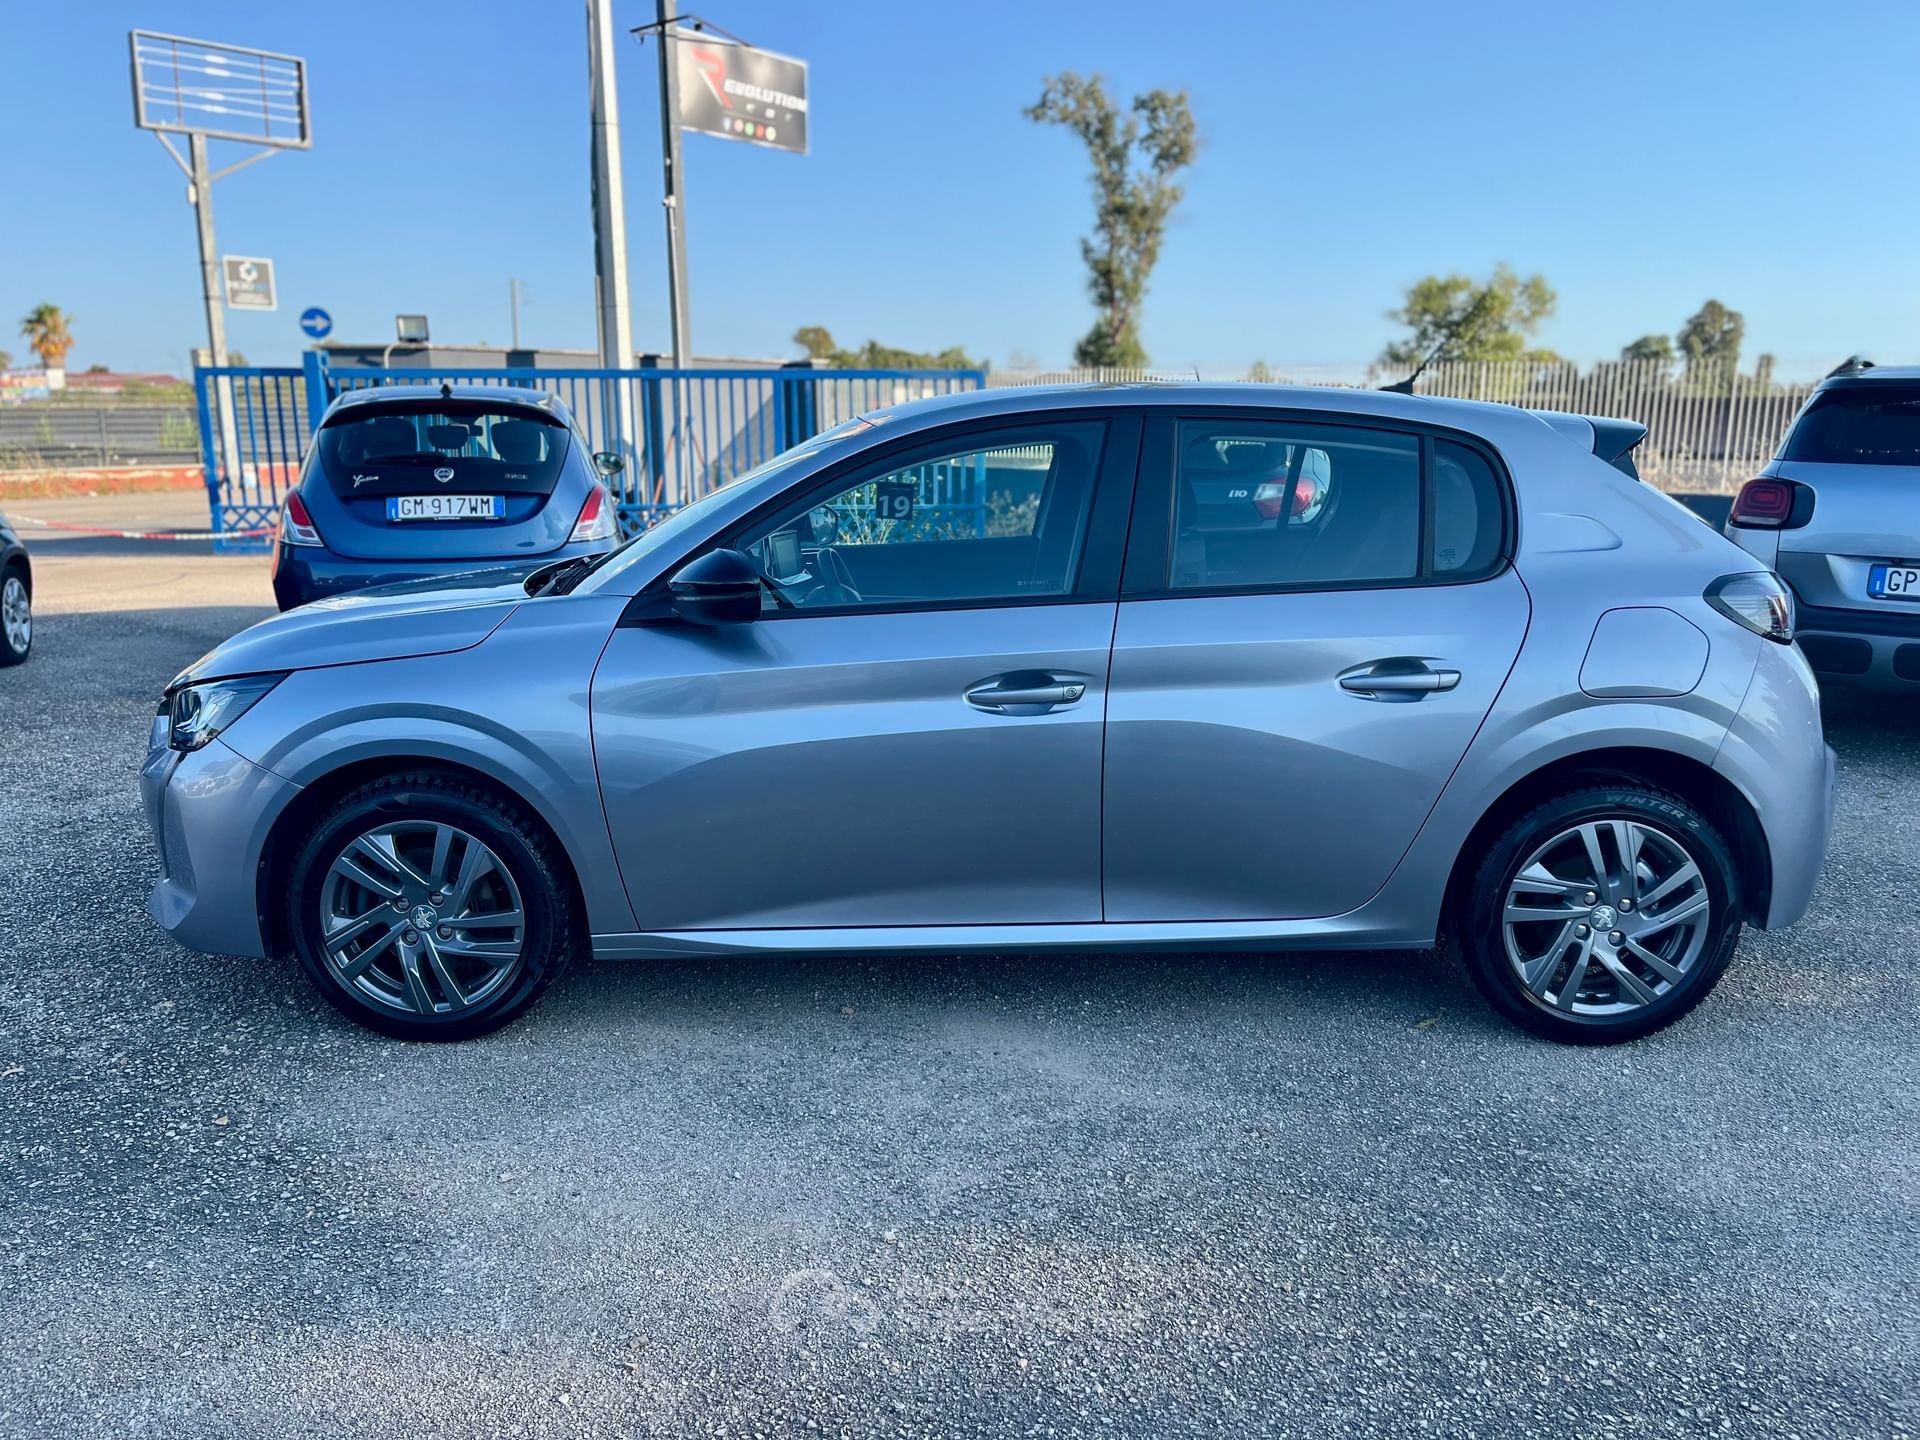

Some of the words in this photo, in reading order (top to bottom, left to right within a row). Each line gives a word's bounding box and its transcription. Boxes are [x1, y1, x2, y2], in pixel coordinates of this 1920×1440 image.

[401, 498, 424, 516] GM
[432, 497, 491, 515] 917WM
[879, 495, 910, 518] 19
[1888, 570, 1918, 593] GP
[1606, 794, 1686, 820] WINTER
